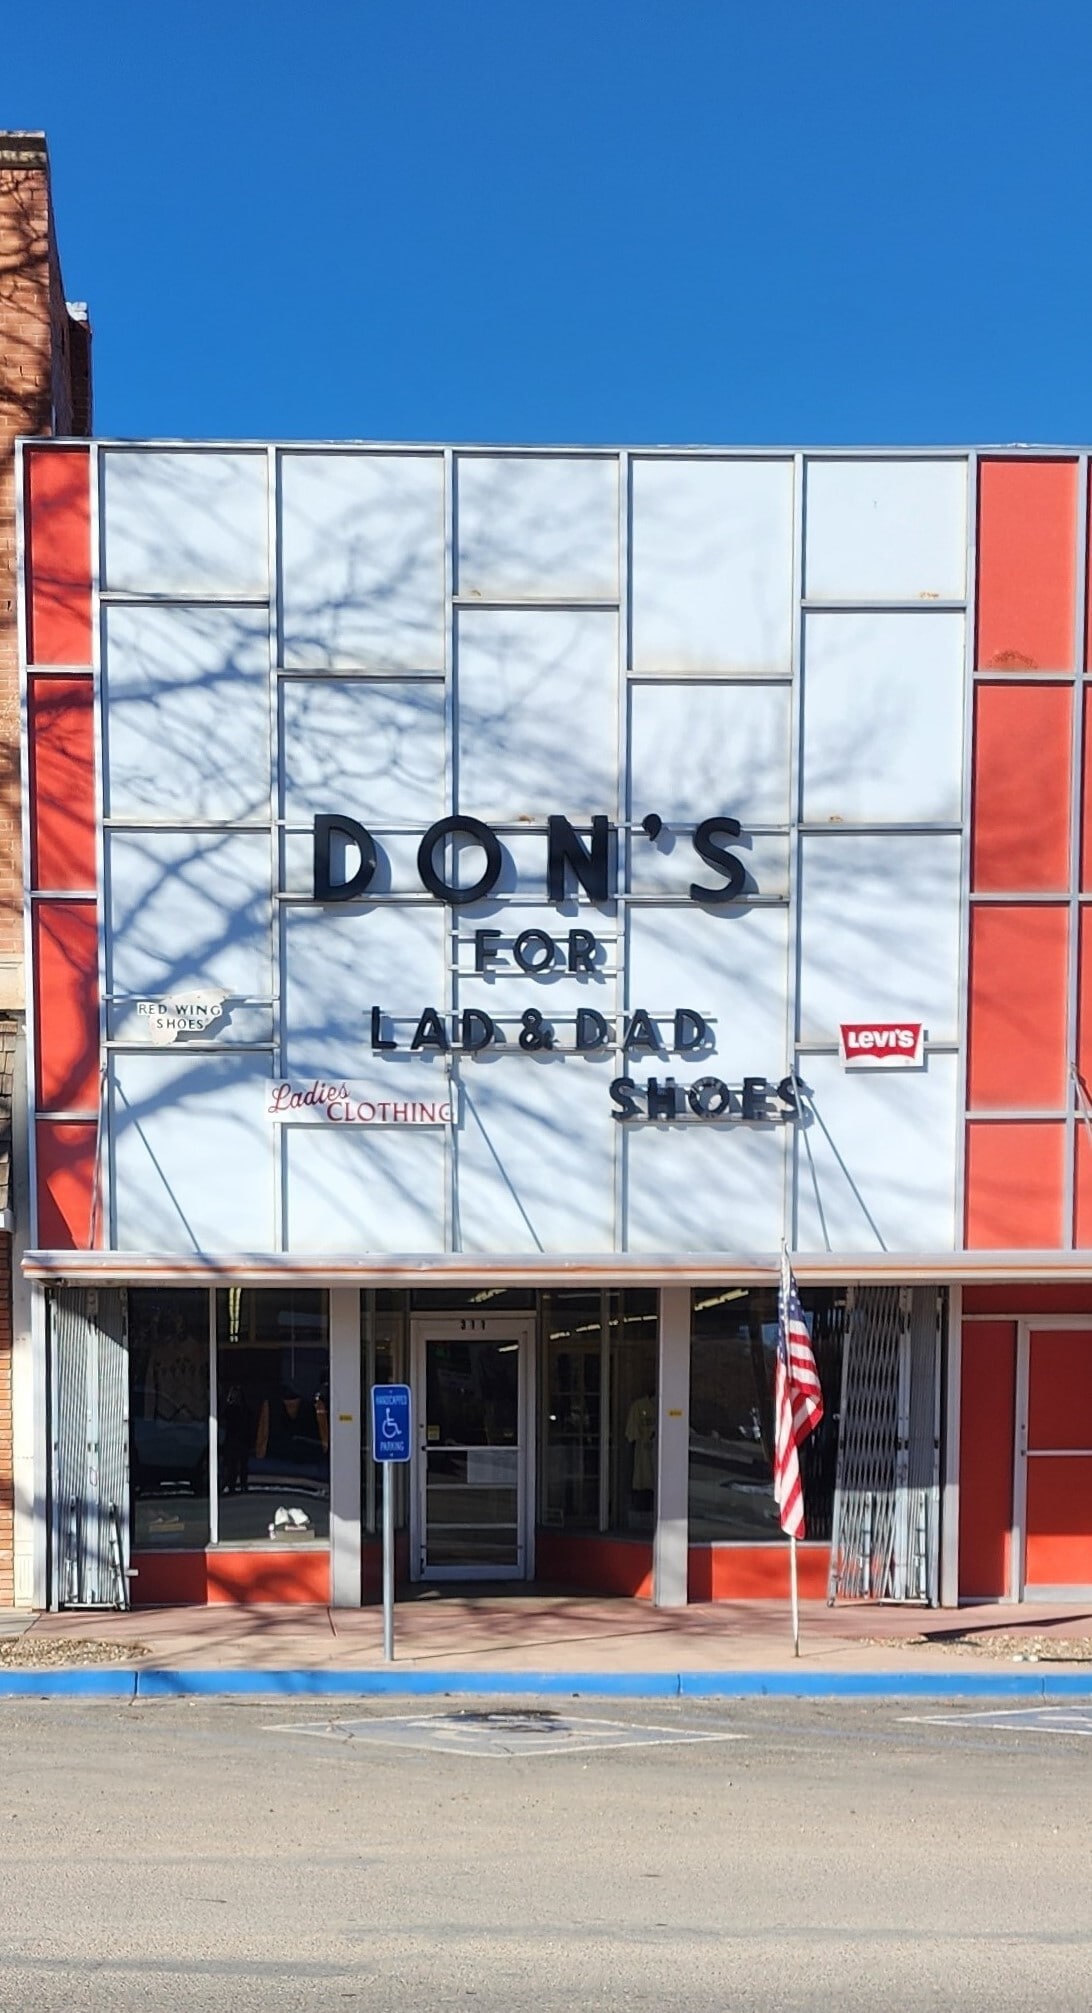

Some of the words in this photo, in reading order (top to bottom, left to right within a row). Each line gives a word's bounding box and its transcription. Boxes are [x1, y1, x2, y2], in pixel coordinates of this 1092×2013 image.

[314, 814, 746, 902] DON'S
[475, 929, 596, 973] FOR
[138, 1003, 168, 1015] RED
[175, 1004, 221, 1016] WING
[156, 1018, 204, 1030] SHOES
[371, 1006, 495, 1050] LAD
[518, 1007, 559, 1050] &
[576, 1008, 706, 1050] DAD
[267, 1080, 350, 1114] Ladies
[609, 1076, 809, 1121] SHOES
[326, 1101, 455, 1123] CLOTHING
[460, 1319, 486, 1331] 311
[380, 1441, 405, 1452] PARKING
